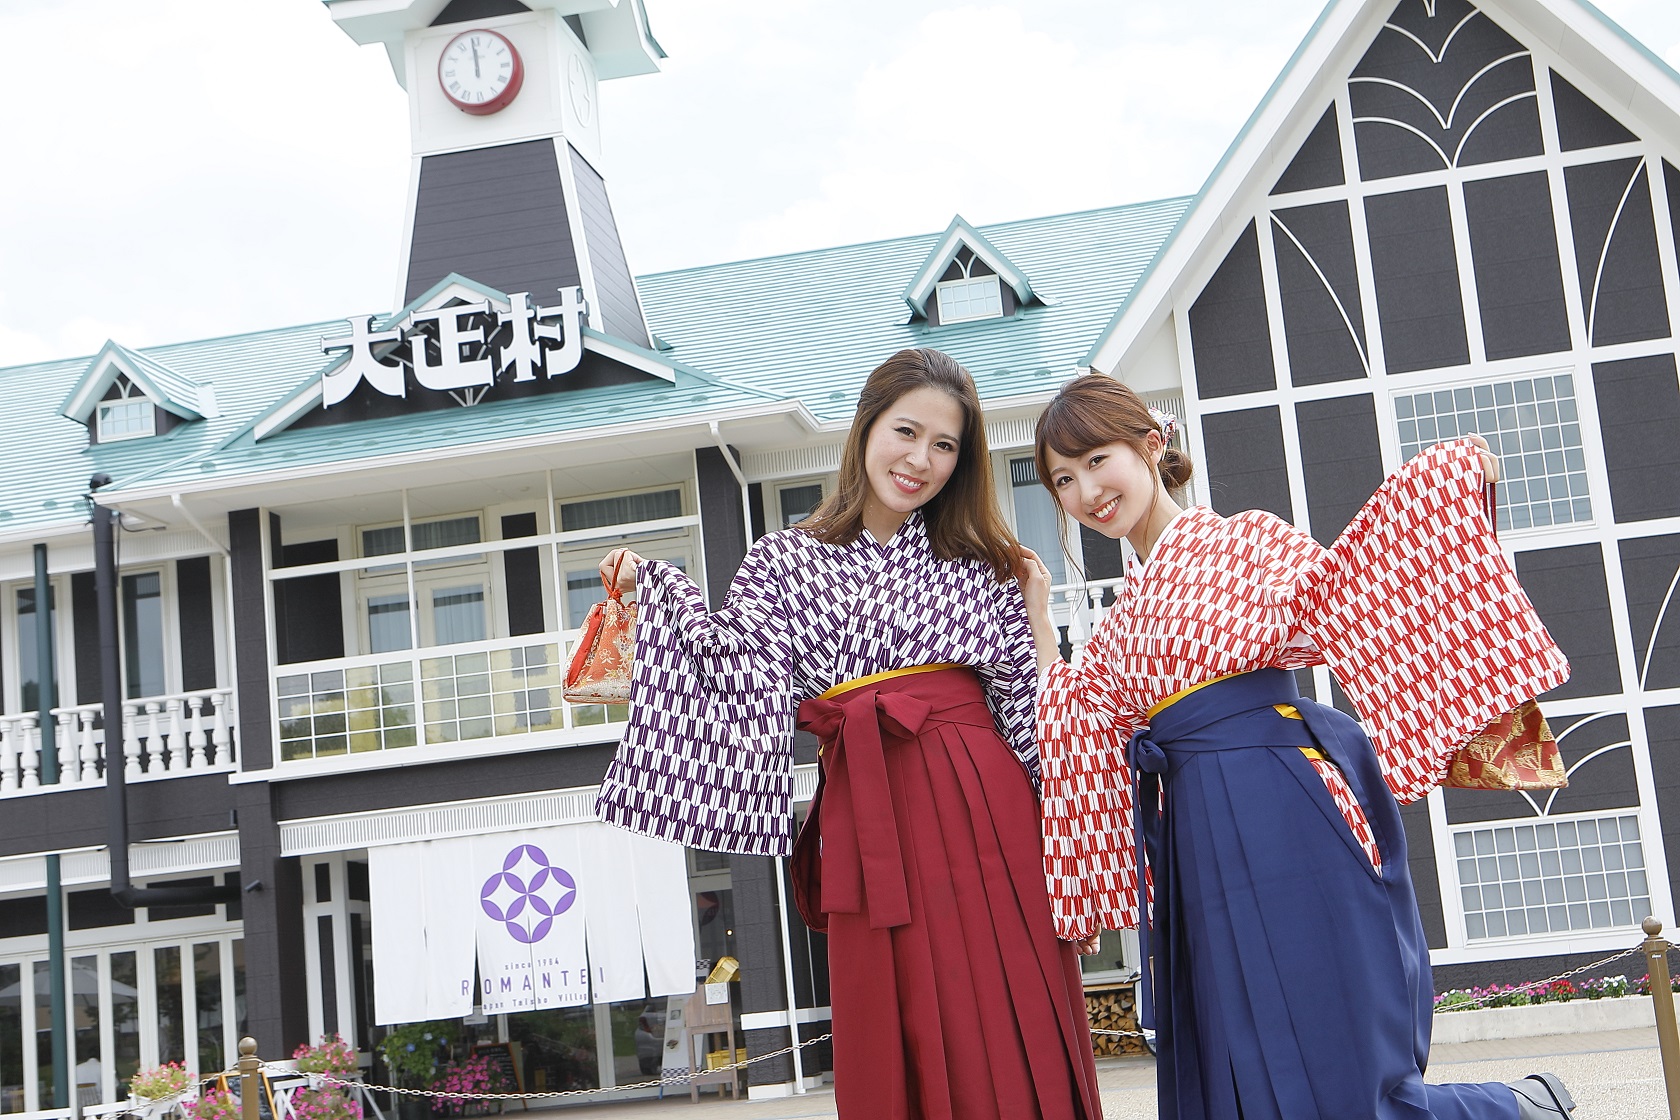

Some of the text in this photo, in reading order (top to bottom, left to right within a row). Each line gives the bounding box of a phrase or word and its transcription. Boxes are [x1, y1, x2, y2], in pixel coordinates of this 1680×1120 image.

[319, 285, 591, 410] 大正村
[504, 957, 560, 971] since 1984
[461, 966, 605, 996] ROMANTEI
